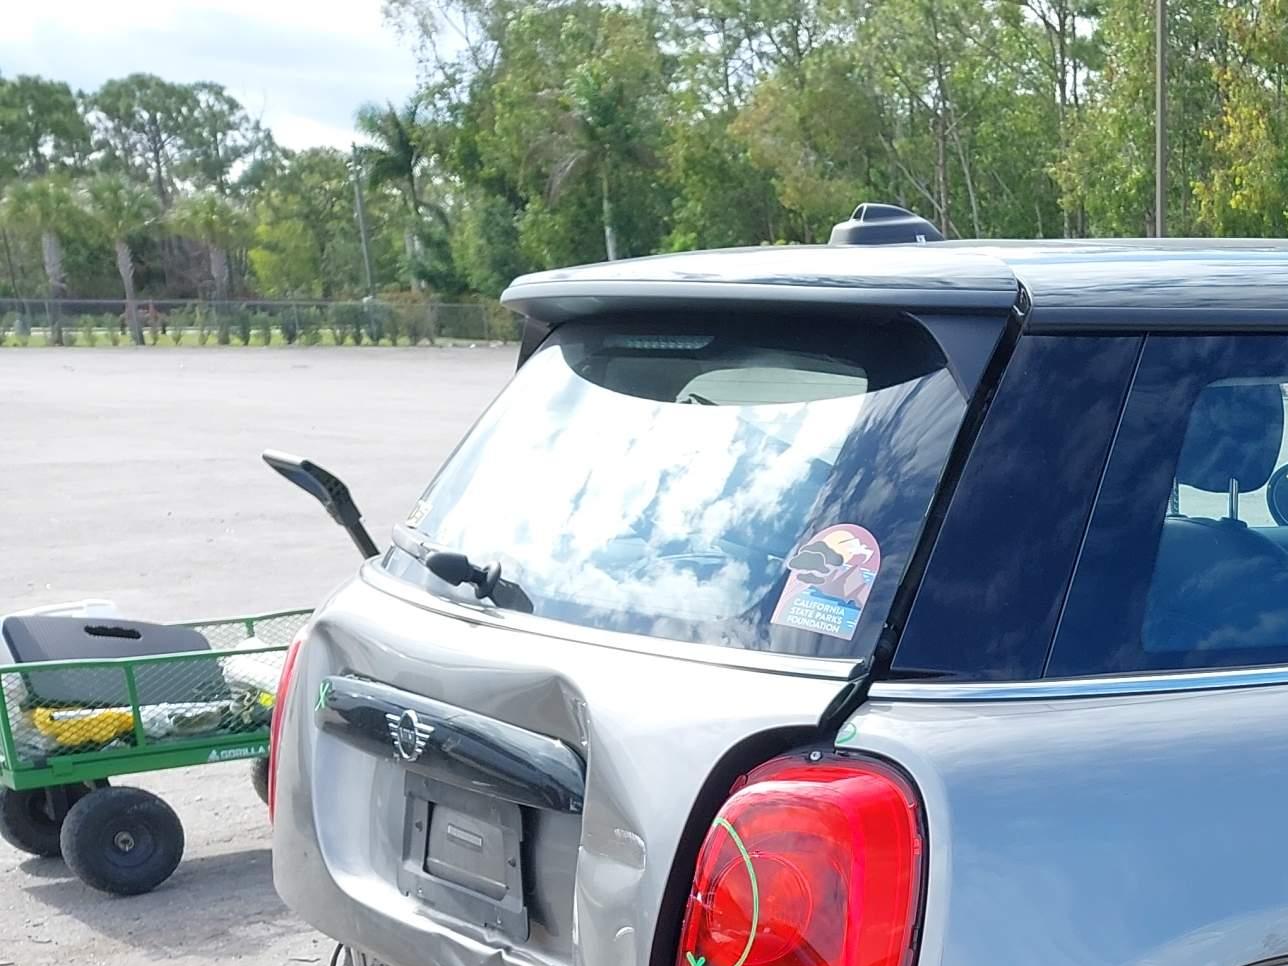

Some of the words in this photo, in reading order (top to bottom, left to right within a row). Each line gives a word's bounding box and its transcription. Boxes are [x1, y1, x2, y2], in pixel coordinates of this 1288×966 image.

[788, 607, 814, 618] STATE
[814, 612, 843, 625] PARKS
[793, 598, 845, 617] CALIFORNIA
[786, 616, 840, 633] FOUNDATION
[220, 745, 265, 759] GORILLA
